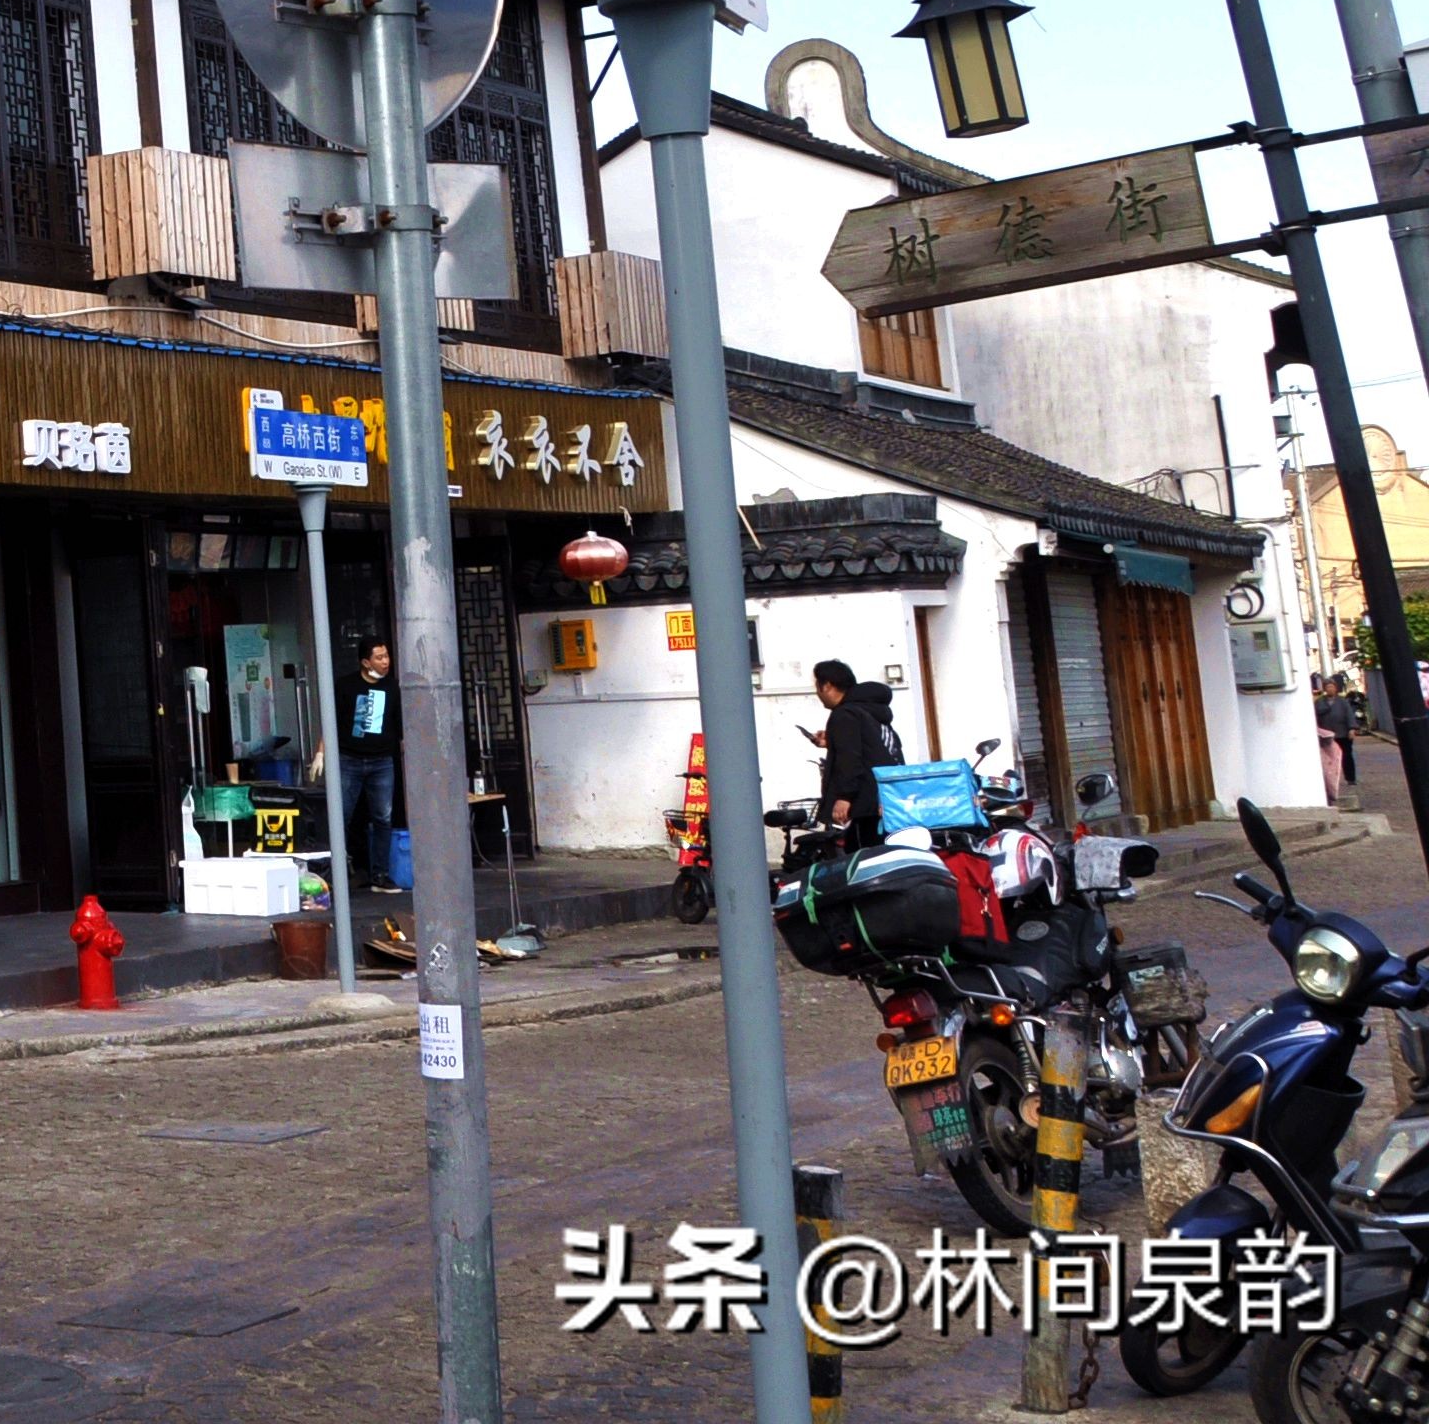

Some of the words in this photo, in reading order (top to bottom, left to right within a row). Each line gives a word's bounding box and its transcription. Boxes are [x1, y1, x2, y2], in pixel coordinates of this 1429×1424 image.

[884, 176, 1168, 286] 树德街
[281, 422, 341, 453] 高桥西街
[264, 460, 273, 473] W
[283, 461, 315, 479] Gaoqiao
[329, 465, 342, 480] (W)
[354, 466, 361, 480] E
[669, 615, 692, 633] 门面
[890, 1055, 951, 1085] QK932
